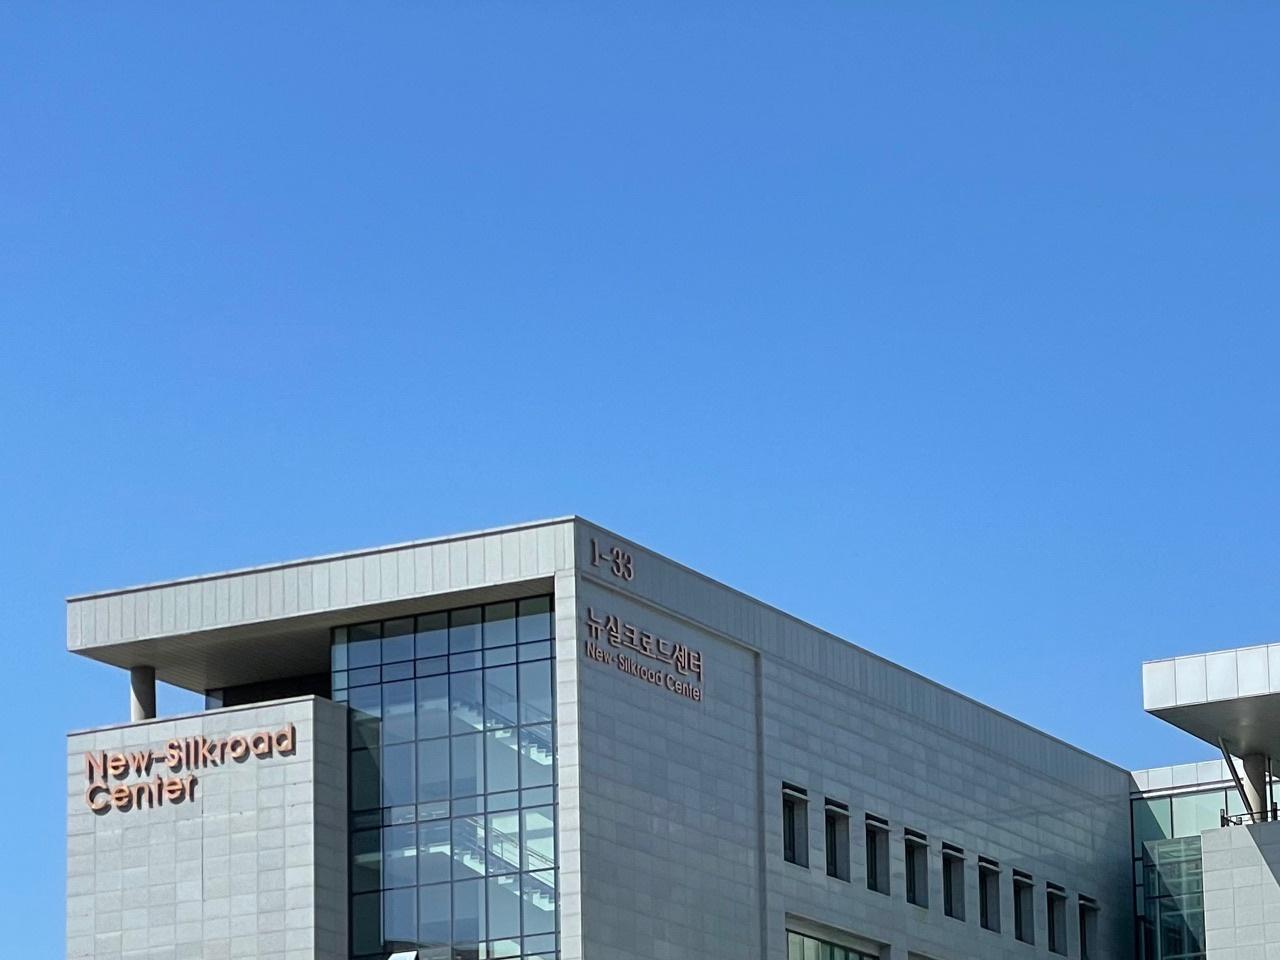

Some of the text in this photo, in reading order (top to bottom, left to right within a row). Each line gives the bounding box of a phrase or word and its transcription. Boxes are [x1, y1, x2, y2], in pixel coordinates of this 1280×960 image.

[590, 538, 635, 581] 1-33
[587, 607, 703, 681] 뉴실크로드센터
[665, 673, 704, 702] Center
[84, 721, 296, 781] New-Silkroad
[84, 774, 198, 814] Center
